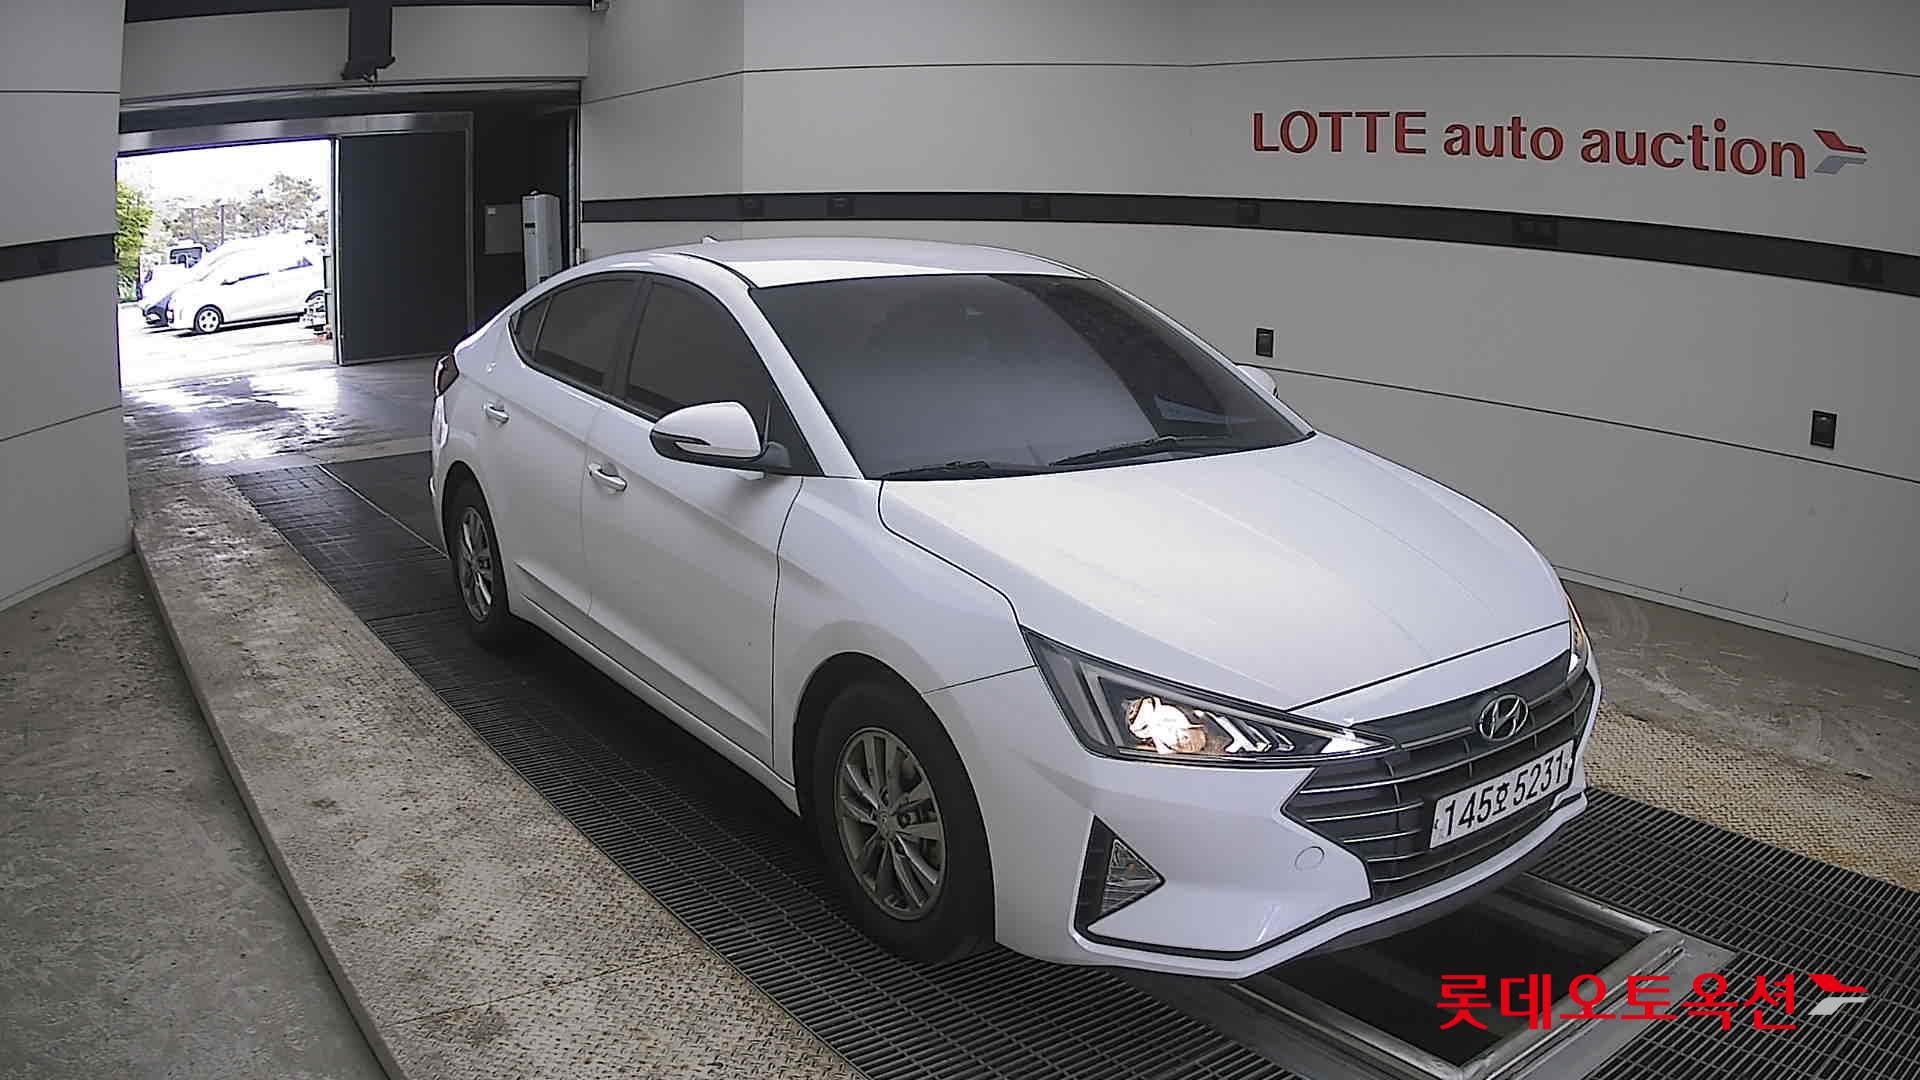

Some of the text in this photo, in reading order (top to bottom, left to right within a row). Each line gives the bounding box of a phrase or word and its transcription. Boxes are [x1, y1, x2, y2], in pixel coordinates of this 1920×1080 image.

[1252, 111, 1806, 180] LOTTE auto auction
